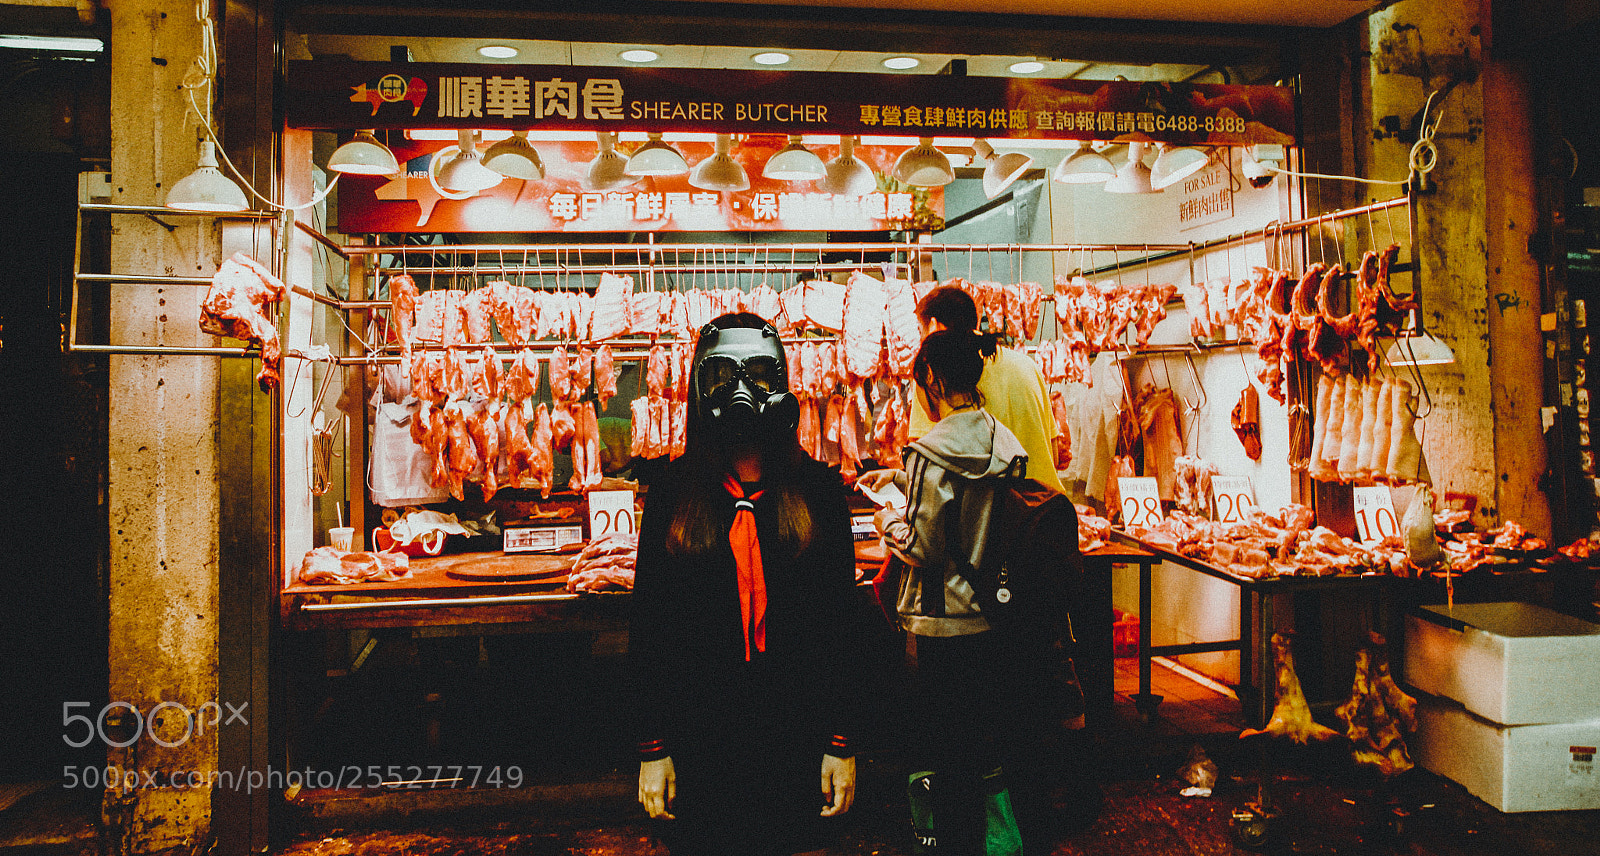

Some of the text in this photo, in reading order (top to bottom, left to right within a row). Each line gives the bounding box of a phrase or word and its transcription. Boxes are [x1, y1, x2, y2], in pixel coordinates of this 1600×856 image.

[437, 76, 625, 120] 順華肉食
[630, 101, 828, 123] SHEARER BUTCHER
[859, 104, 1246, 133] 專營食肆鮮肉供應 查詢報價請電6488-8388
[1184, 170, 1222, 195] FOR SALE
[594, 508, 633, 535] 20
[1124, 497, 1161, 527] 28
[1218, 493, 1253, 523] 20
[1356, 507, 1397, 542] 10
